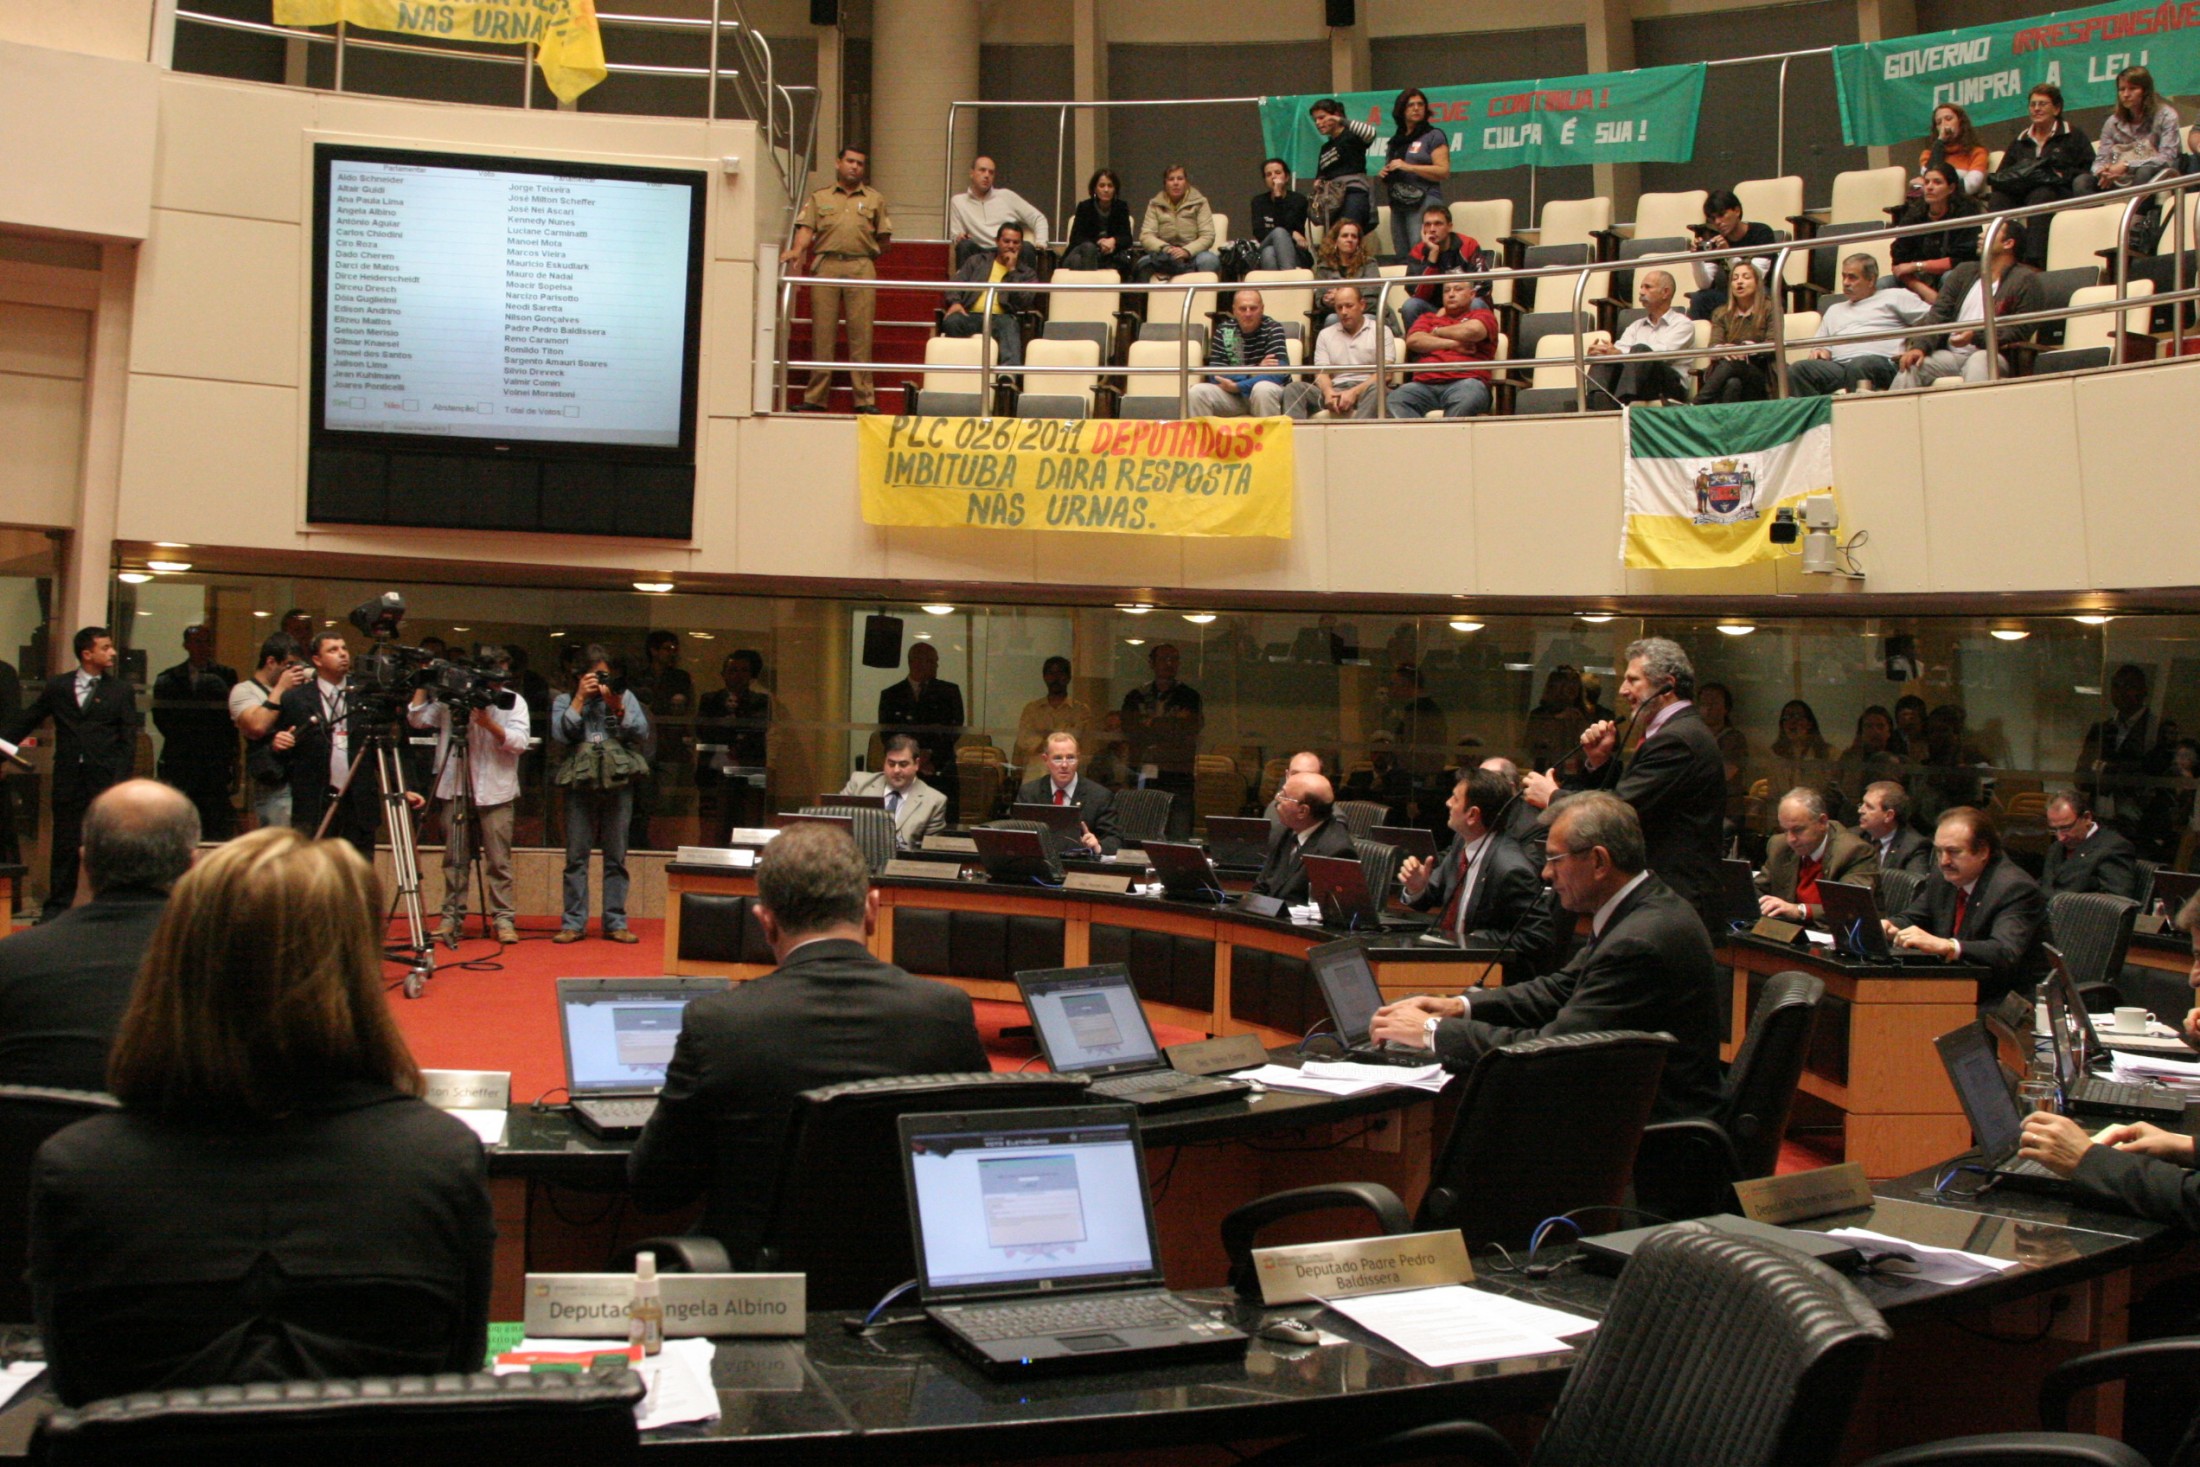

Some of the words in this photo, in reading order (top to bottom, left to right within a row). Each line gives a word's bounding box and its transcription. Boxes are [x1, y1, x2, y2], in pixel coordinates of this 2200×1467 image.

[396, 3, 454, 33] NAS
[1883, 36, 1992, 80] GOVERNO
[1932, 69, 2021, 110] CUMPRA
[2045, 61, 2061, 88] A
[1367, 106, 1381, 125] A
[1428, 101, 1471, 123] EVE
[1487, 87, 1610, 119] CONTINUA!
[1449, 132, 1463, 152] A
[1483, 122, 1542, 149] CULPA
[1560, 117, 1578, 145] É
[887, 416, 949, 449] PLC
[955, 418, 1086, 453] 026/2011
[1091, 420, 1264, 459] DEPUTADOS:
[884, 451, 1017, 487] IMBITUBA
[1035, 451, 1108, 490] DARÁ
[1115, 458, 1252, 496] RESPOSTA
[966, 492, 1025, 527] NAS
[1046, 494, 1156, 530] URNAS.
[1296, 1261, 1358, 1279] Deputado
[1361, 1257, 1396, 1271] Padre
[1399, 1253, 1436, 1267] Pedro
[1336, 1272, 1400, 1290] Baldissera
[665, 1299, 718, 1321] ngela
[724, 1299, 787, 1316] Albino
